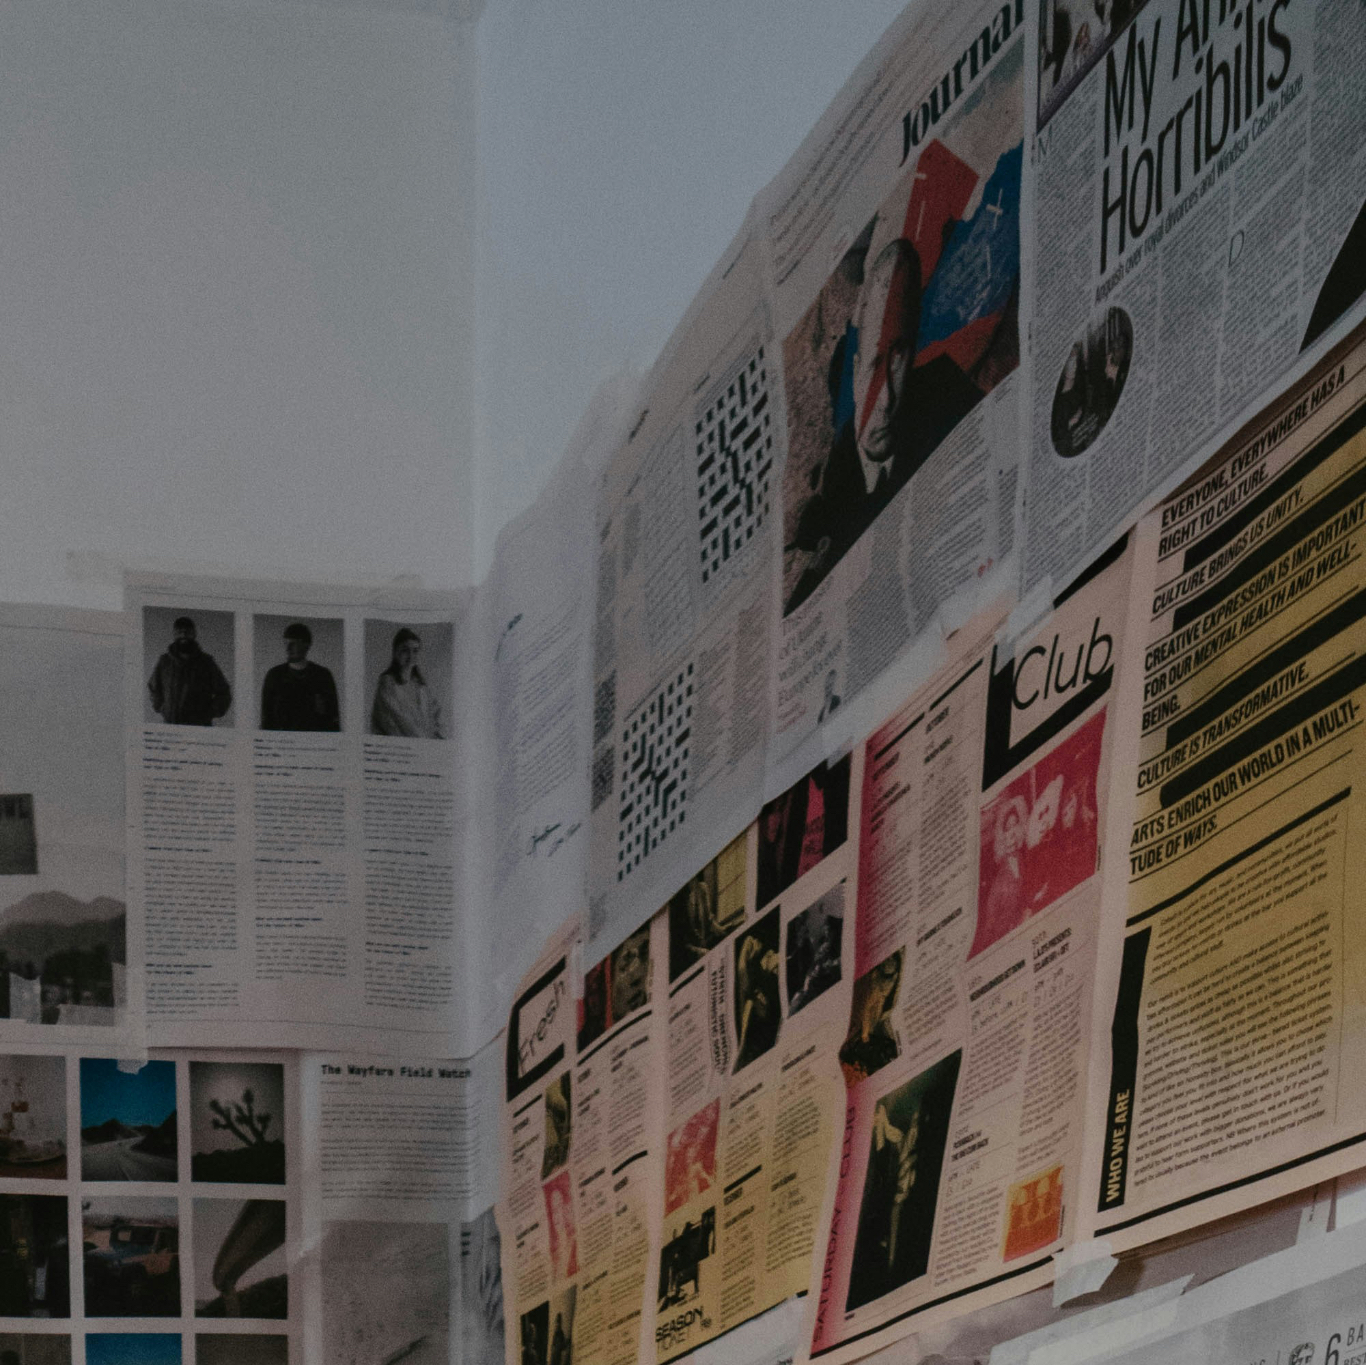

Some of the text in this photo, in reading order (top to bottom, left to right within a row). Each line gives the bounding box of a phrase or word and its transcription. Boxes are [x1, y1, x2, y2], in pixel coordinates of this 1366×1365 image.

[898, 0, 1025, 168] Journal
[1100, 0, 1293, 275] Horribilis
[1102, 15, 1163, 160] My
[1158, 461, 1270, 557] RIGHT TO CULTURE.
[1161, 365, 1346, 528] EVERYONE, EVERYWHERE HAS A
[1144, 499, 1366, 673] CREATIVE EXPRESSION IS IMPORTANT
[1152, 484, 1304, 614] CULTURE BRINGS US UNITY.
[1011, 617, 1114, 711] Club
[1143, 540, 1358, 702] FOR OUR MENTAL HEALTH AND WELL-
[1130, 699, 1362, 848] ARTS ENRICH OUR WORLD IN A MULTI-
[1136, 660, 1311, 789] CULTURE IS TRANSFORMATIVE.
[1141, 695, 1182, 732] BEING.
[1129, 813, 1220, 876] TUDE OF WAYS.
[321, 1063, 342, 1077] The
[400, 1066, 434, 1080] Field
[1106, 1088, 1131, 1203] WHO WE ARE
